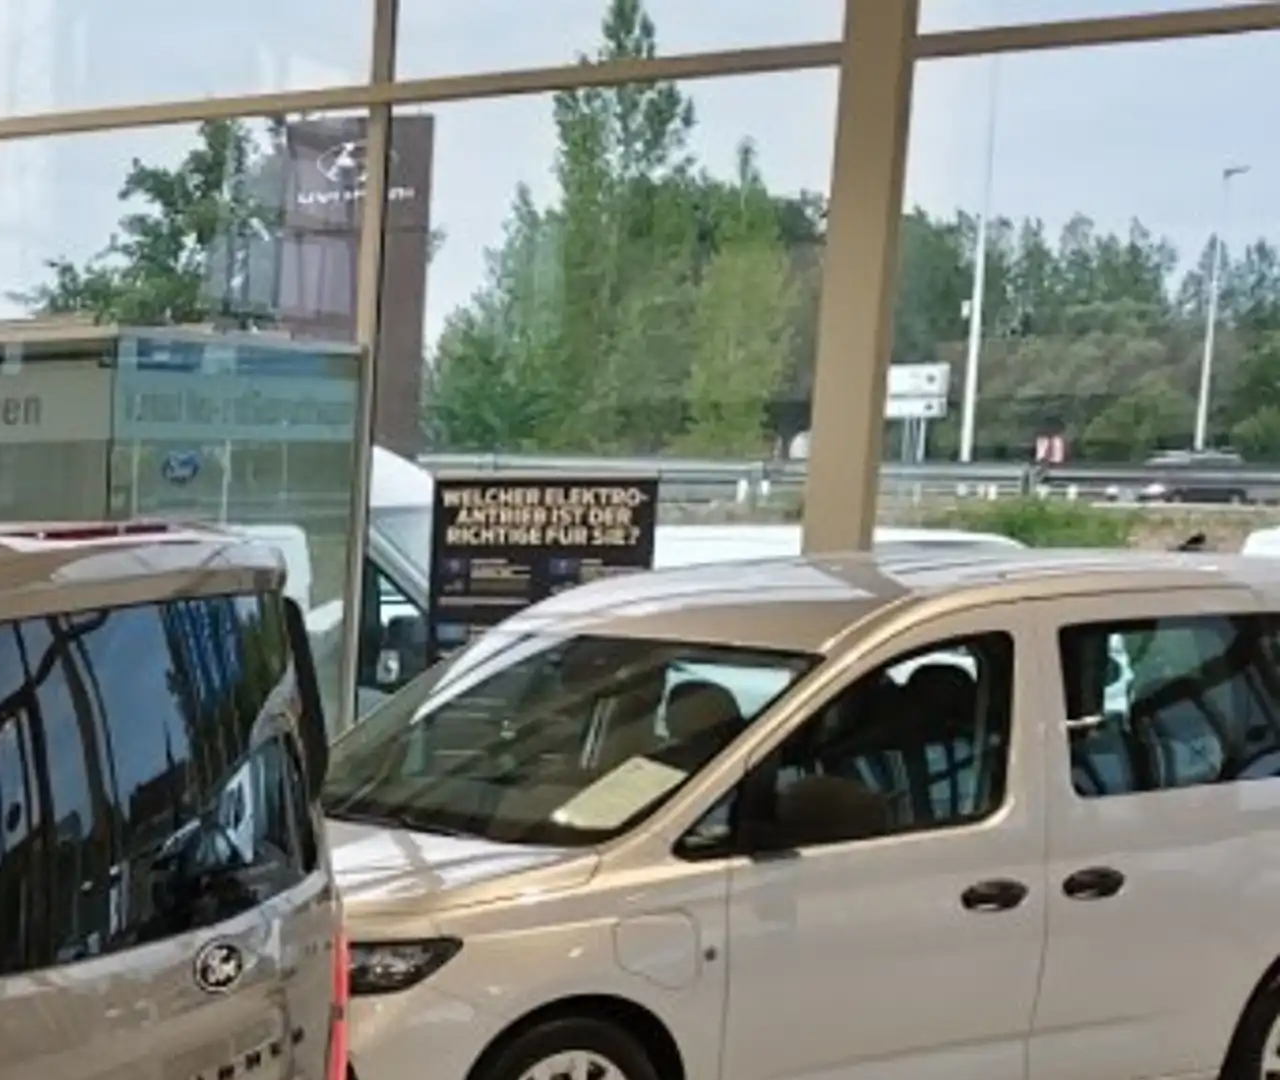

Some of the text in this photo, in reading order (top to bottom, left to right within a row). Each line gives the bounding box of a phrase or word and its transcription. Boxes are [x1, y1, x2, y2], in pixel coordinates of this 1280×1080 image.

[442, 487, 540, 507] WELCHER
[550, 507, 585, 526] IST
[589, 507, 633, 526] DER
[445, 526, 541, 545] RICHTIGE
